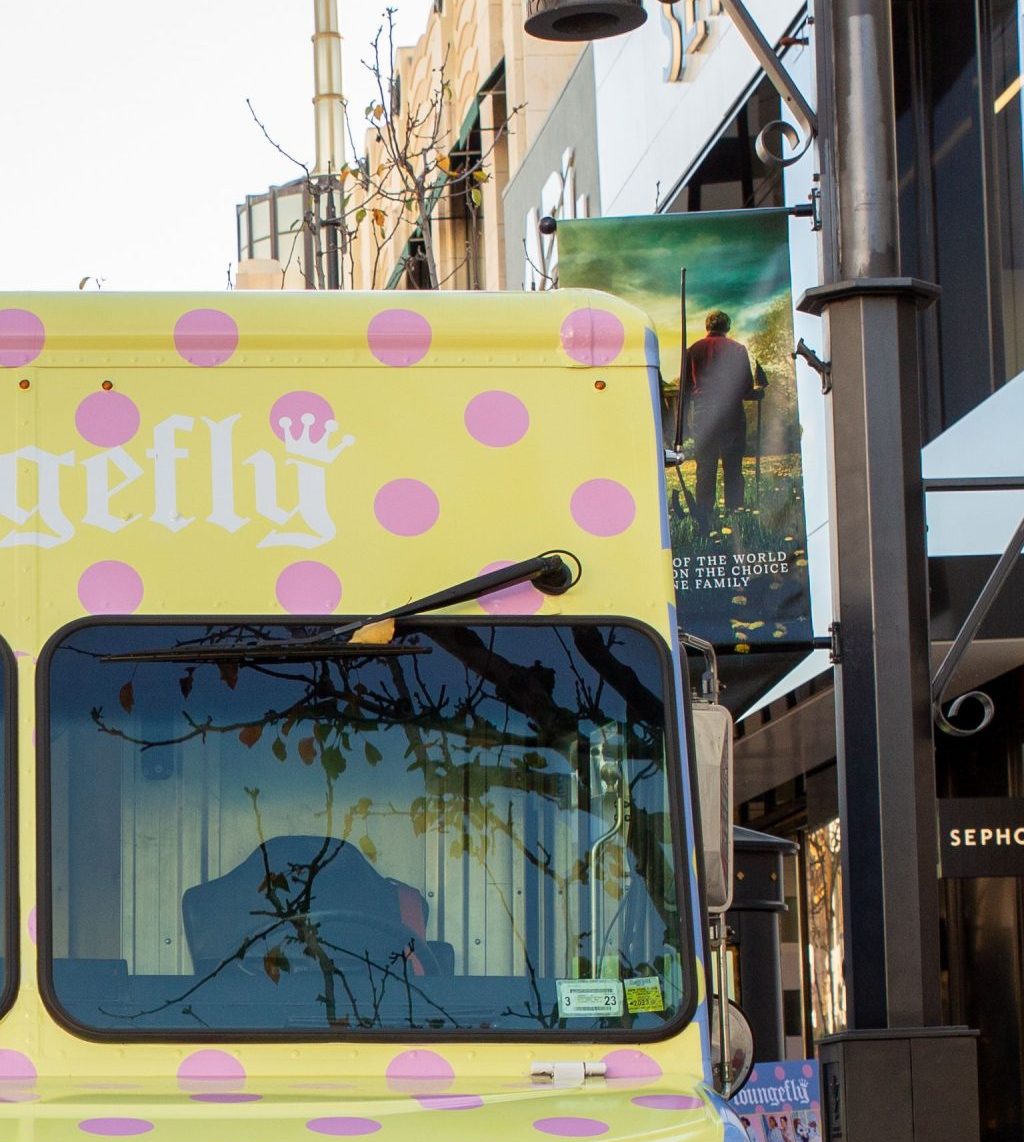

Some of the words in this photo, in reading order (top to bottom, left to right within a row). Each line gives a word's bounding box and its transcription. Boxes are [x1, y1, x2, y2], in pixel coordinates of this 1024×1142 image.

[673, 557, 691, 568] OF
[696, 555, 727, 566] THE
[733, 551, 787, 564] WORLD
[696, 566, 726, 578] THE
[731, 563, 789, 576] CHOICE
[696, 577, 750, 589] FAMILY
[604, 995, 617, 1006] 23
